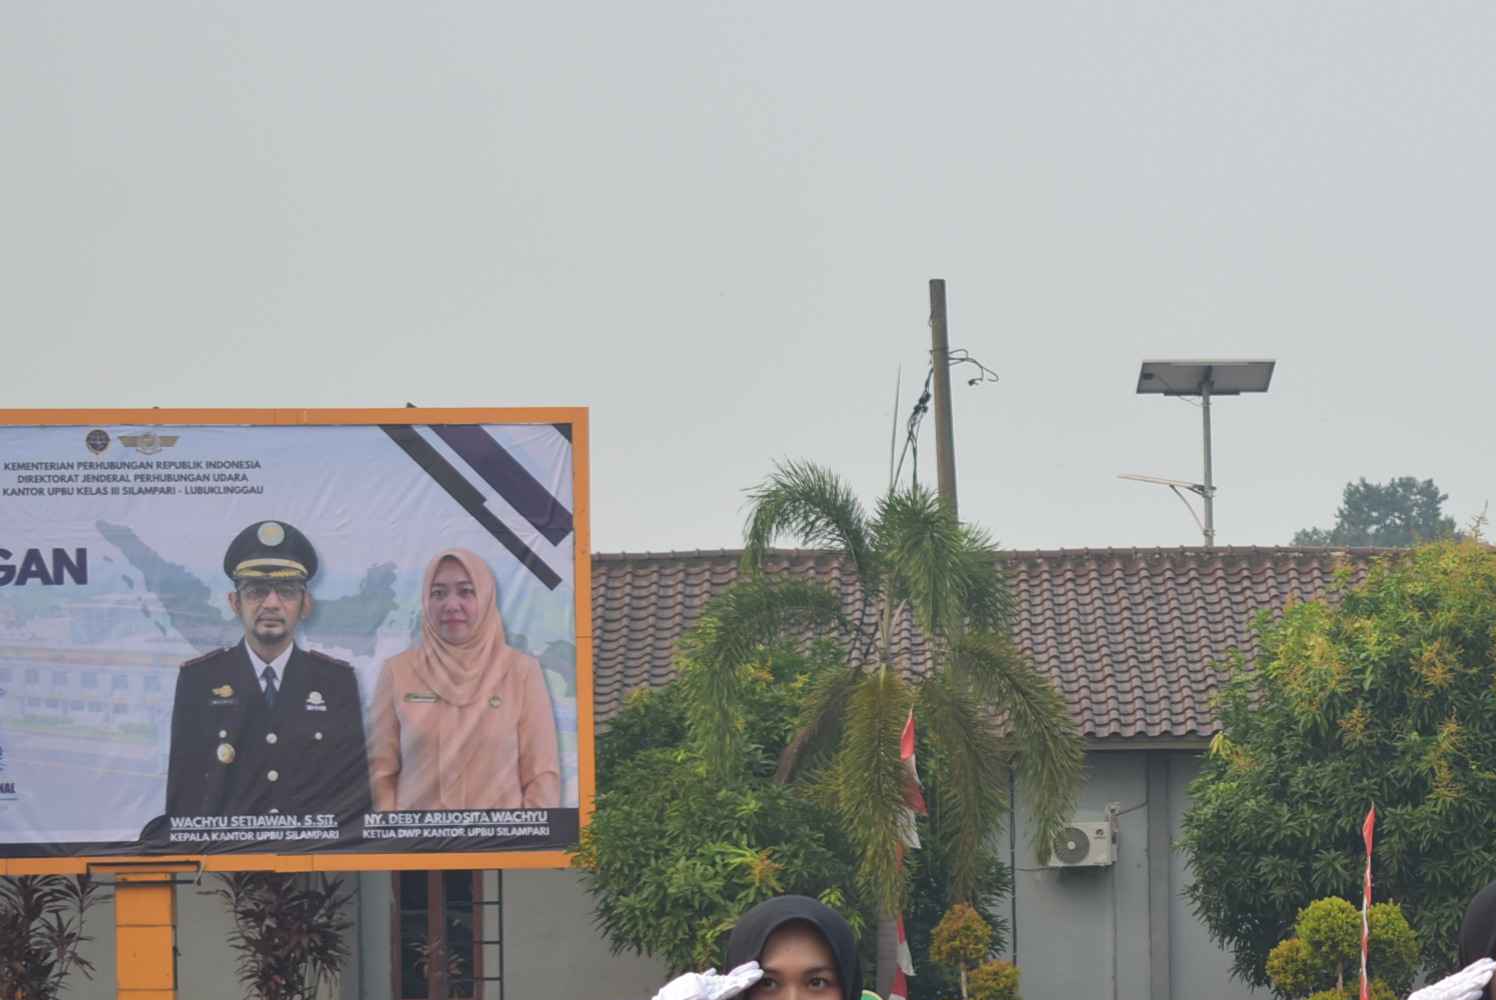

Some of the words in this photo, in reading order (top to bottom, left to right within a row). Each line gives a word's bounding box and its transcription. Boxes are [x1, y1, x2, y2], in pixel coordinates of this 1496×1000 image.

[4, 461, 74, 471] KEMENTERIAN
[77, 461, 153, 470] PERHUBUNGAN
[156, 461, 203, 470] REPUBLIK
[206, 460, 261, 469] INDONESIA
[17, 474, 80, 483] DIREKTORAT
[82, 474, 131, 483] JENDERAL
[134, 473, 210, 482] PERHUBUNGAN
[212, 473, 248, 482] UDARA
[2, 487, 45, 496] KANTOR
[48, 487, 74, 496] UPBU
[77, 487, 108, 496] KELAS
[111, 486, 120, 495] III
[122, 486, 176, 495] SILAMPARI
[184, 486, 264, 495] LUBUKLINGGAU
[170, 816, 228, 828] WACHYU
[364, 814, 386, 825] NY.
[389, 813, 421, 824] DEBY
[424, 812, 489, 824] ARIJOSITA
[492, 811, 548, 822] WACHYU
[169, 832, 210, 842] KEPALA
[211, 831, 254, 841] KANTOR
[256, 831, 284, 840] UPBU
[285, 830, 339, 840] SILAMPARI
[362, 829, 398, 838] KETUA
[398, 828, 422, 838] DWP
[423, 828, 465, 837] KANTOR
[468, 827, 495, 836] UPBU
[496, 827, 550, 836] SILAMPARI
